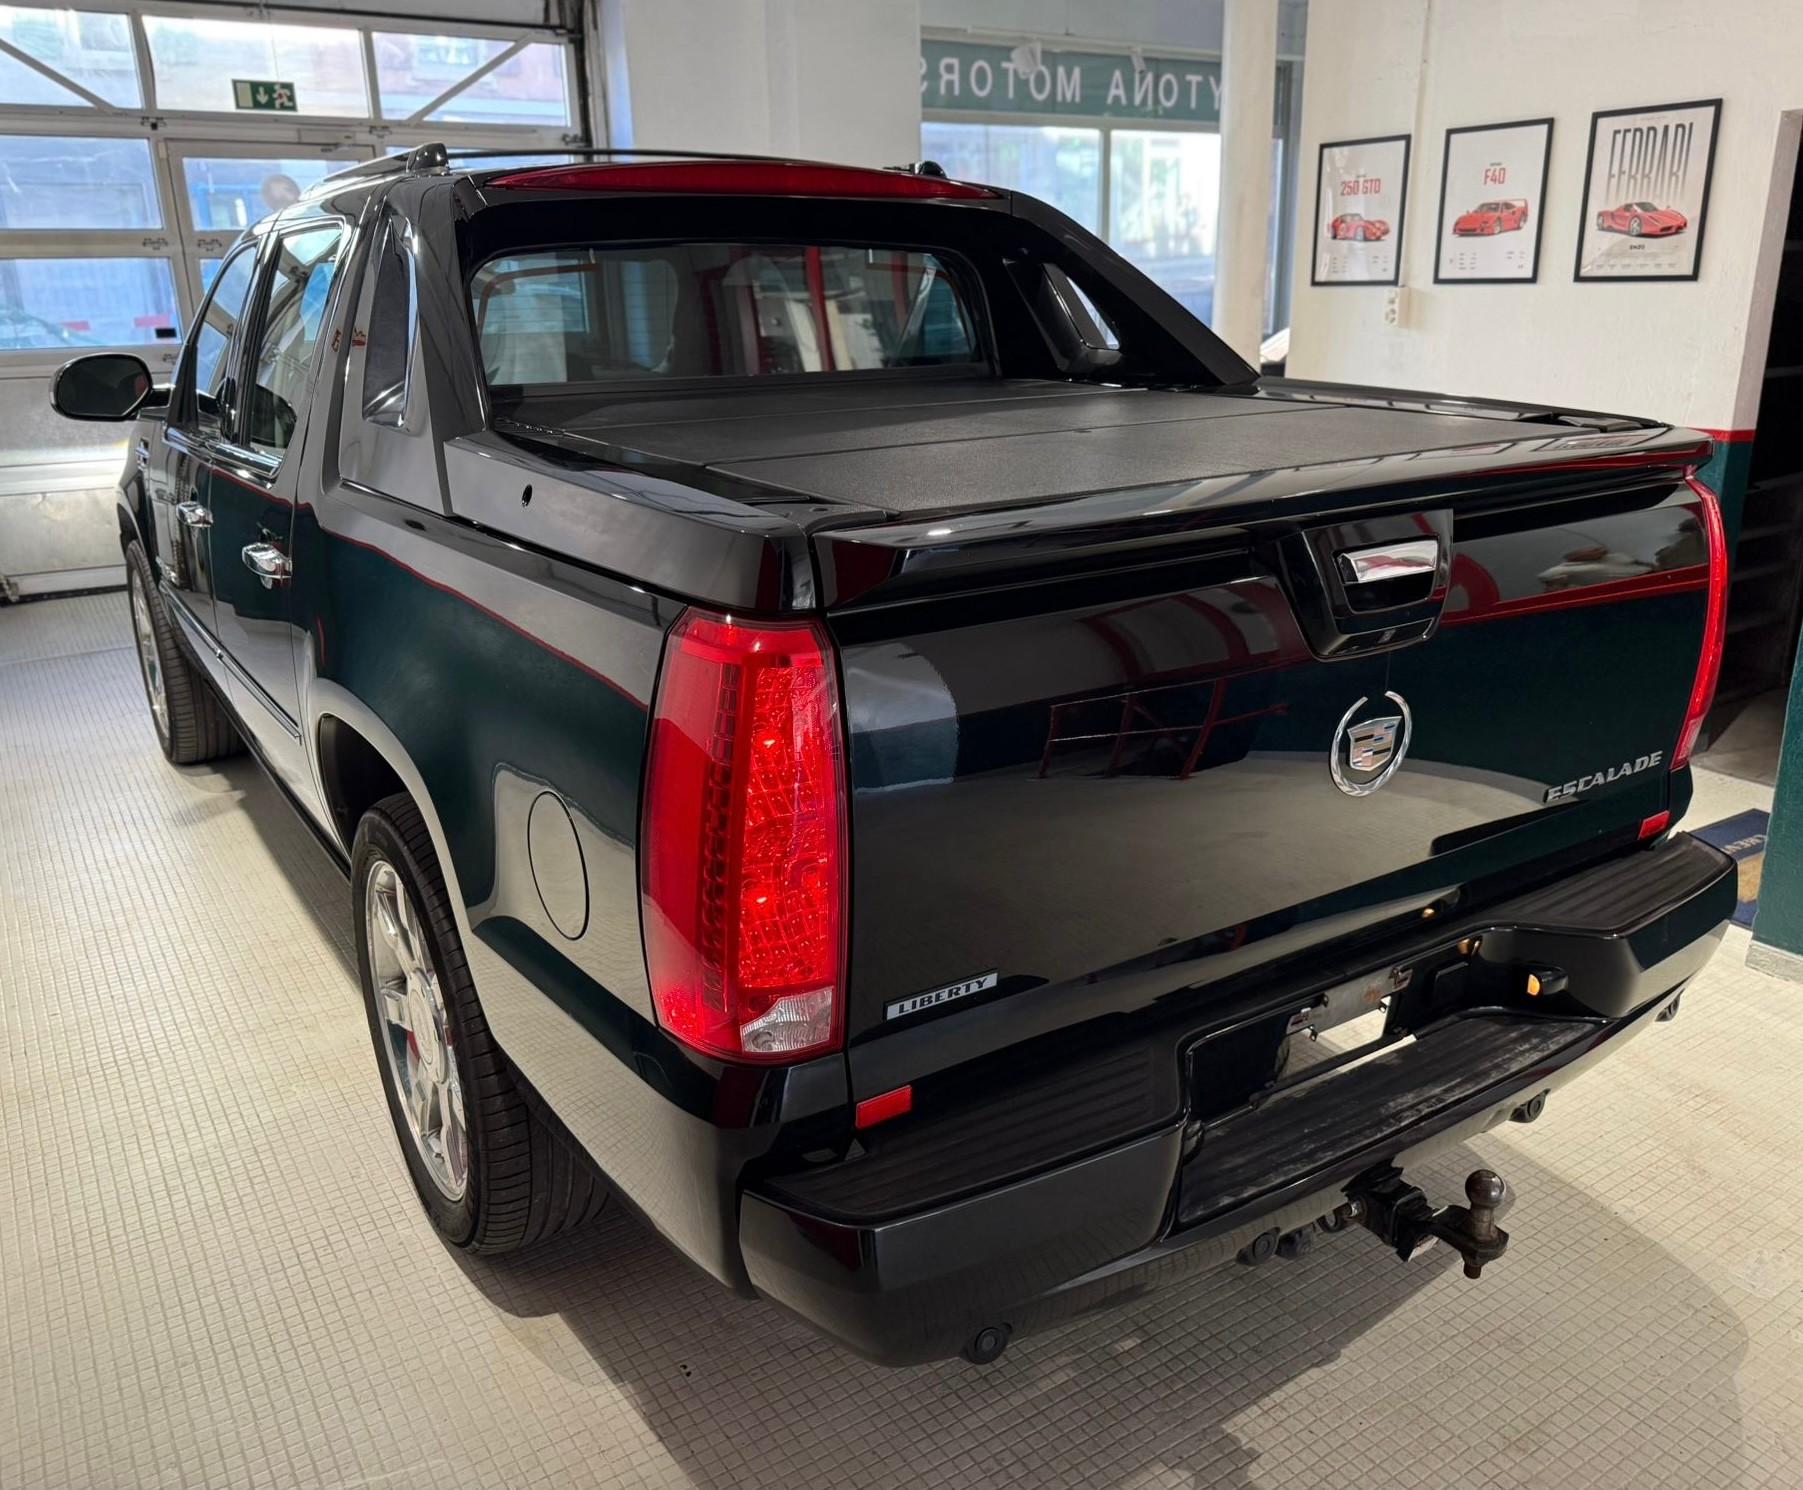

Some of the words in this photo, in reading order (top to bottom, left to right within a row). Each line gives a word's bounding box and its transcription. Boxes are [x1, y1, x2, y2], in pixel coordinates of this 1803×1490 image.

[1483, 167, 1506, 186] F40
[1604, 121, 1694, 203] FERRARI
[1340, 180, 1360, 197] 250
[1361, 178, 1382, 195] GTO
[1545, 750, 1663, 801] ESCALADE
[898, 977, 988, 1014] LIBERTY
